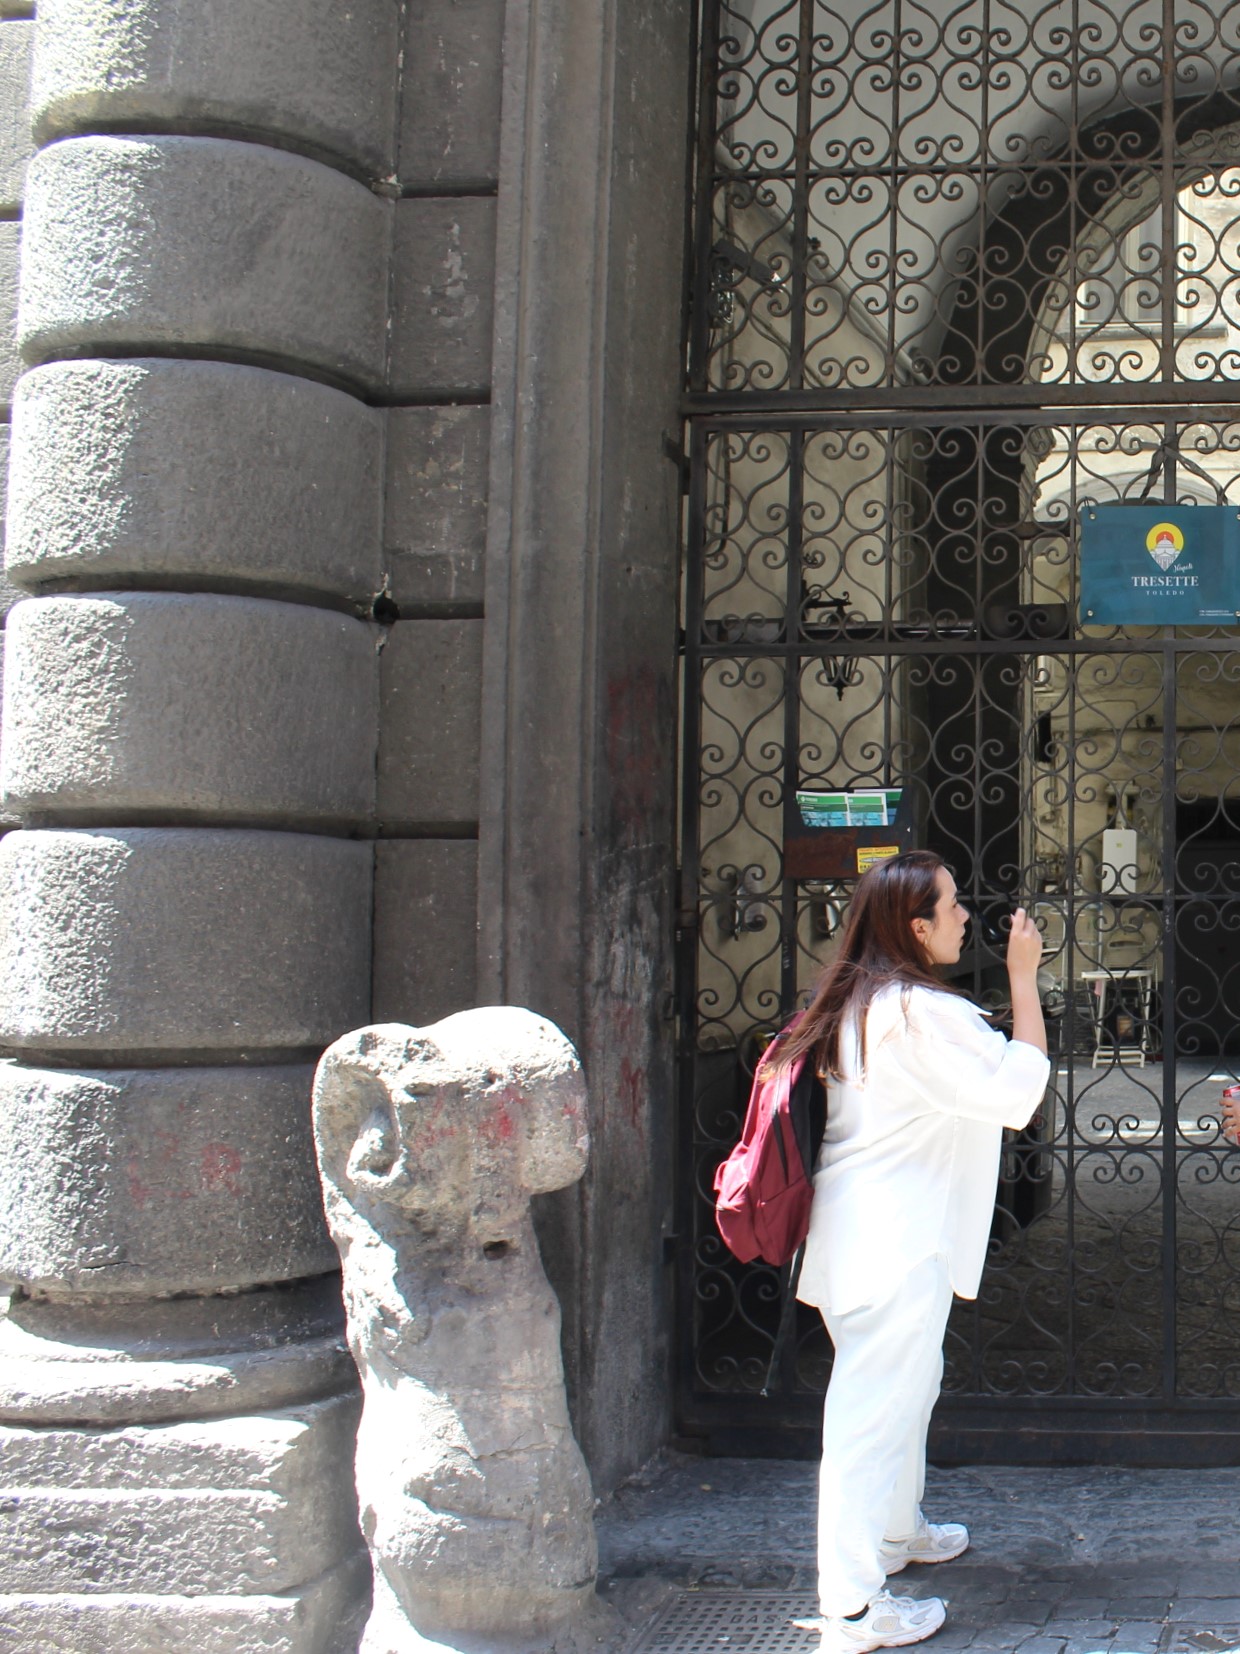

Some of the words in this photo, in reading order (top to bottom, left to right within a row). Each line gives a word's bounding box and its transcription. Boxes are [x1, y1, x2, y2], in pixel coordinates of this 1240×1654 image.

[1173, 563, 1193, 573] Napoli
[1131, 576, 1199, 587] TRESETTE
[729, 1614, 779, 1625] GAS
